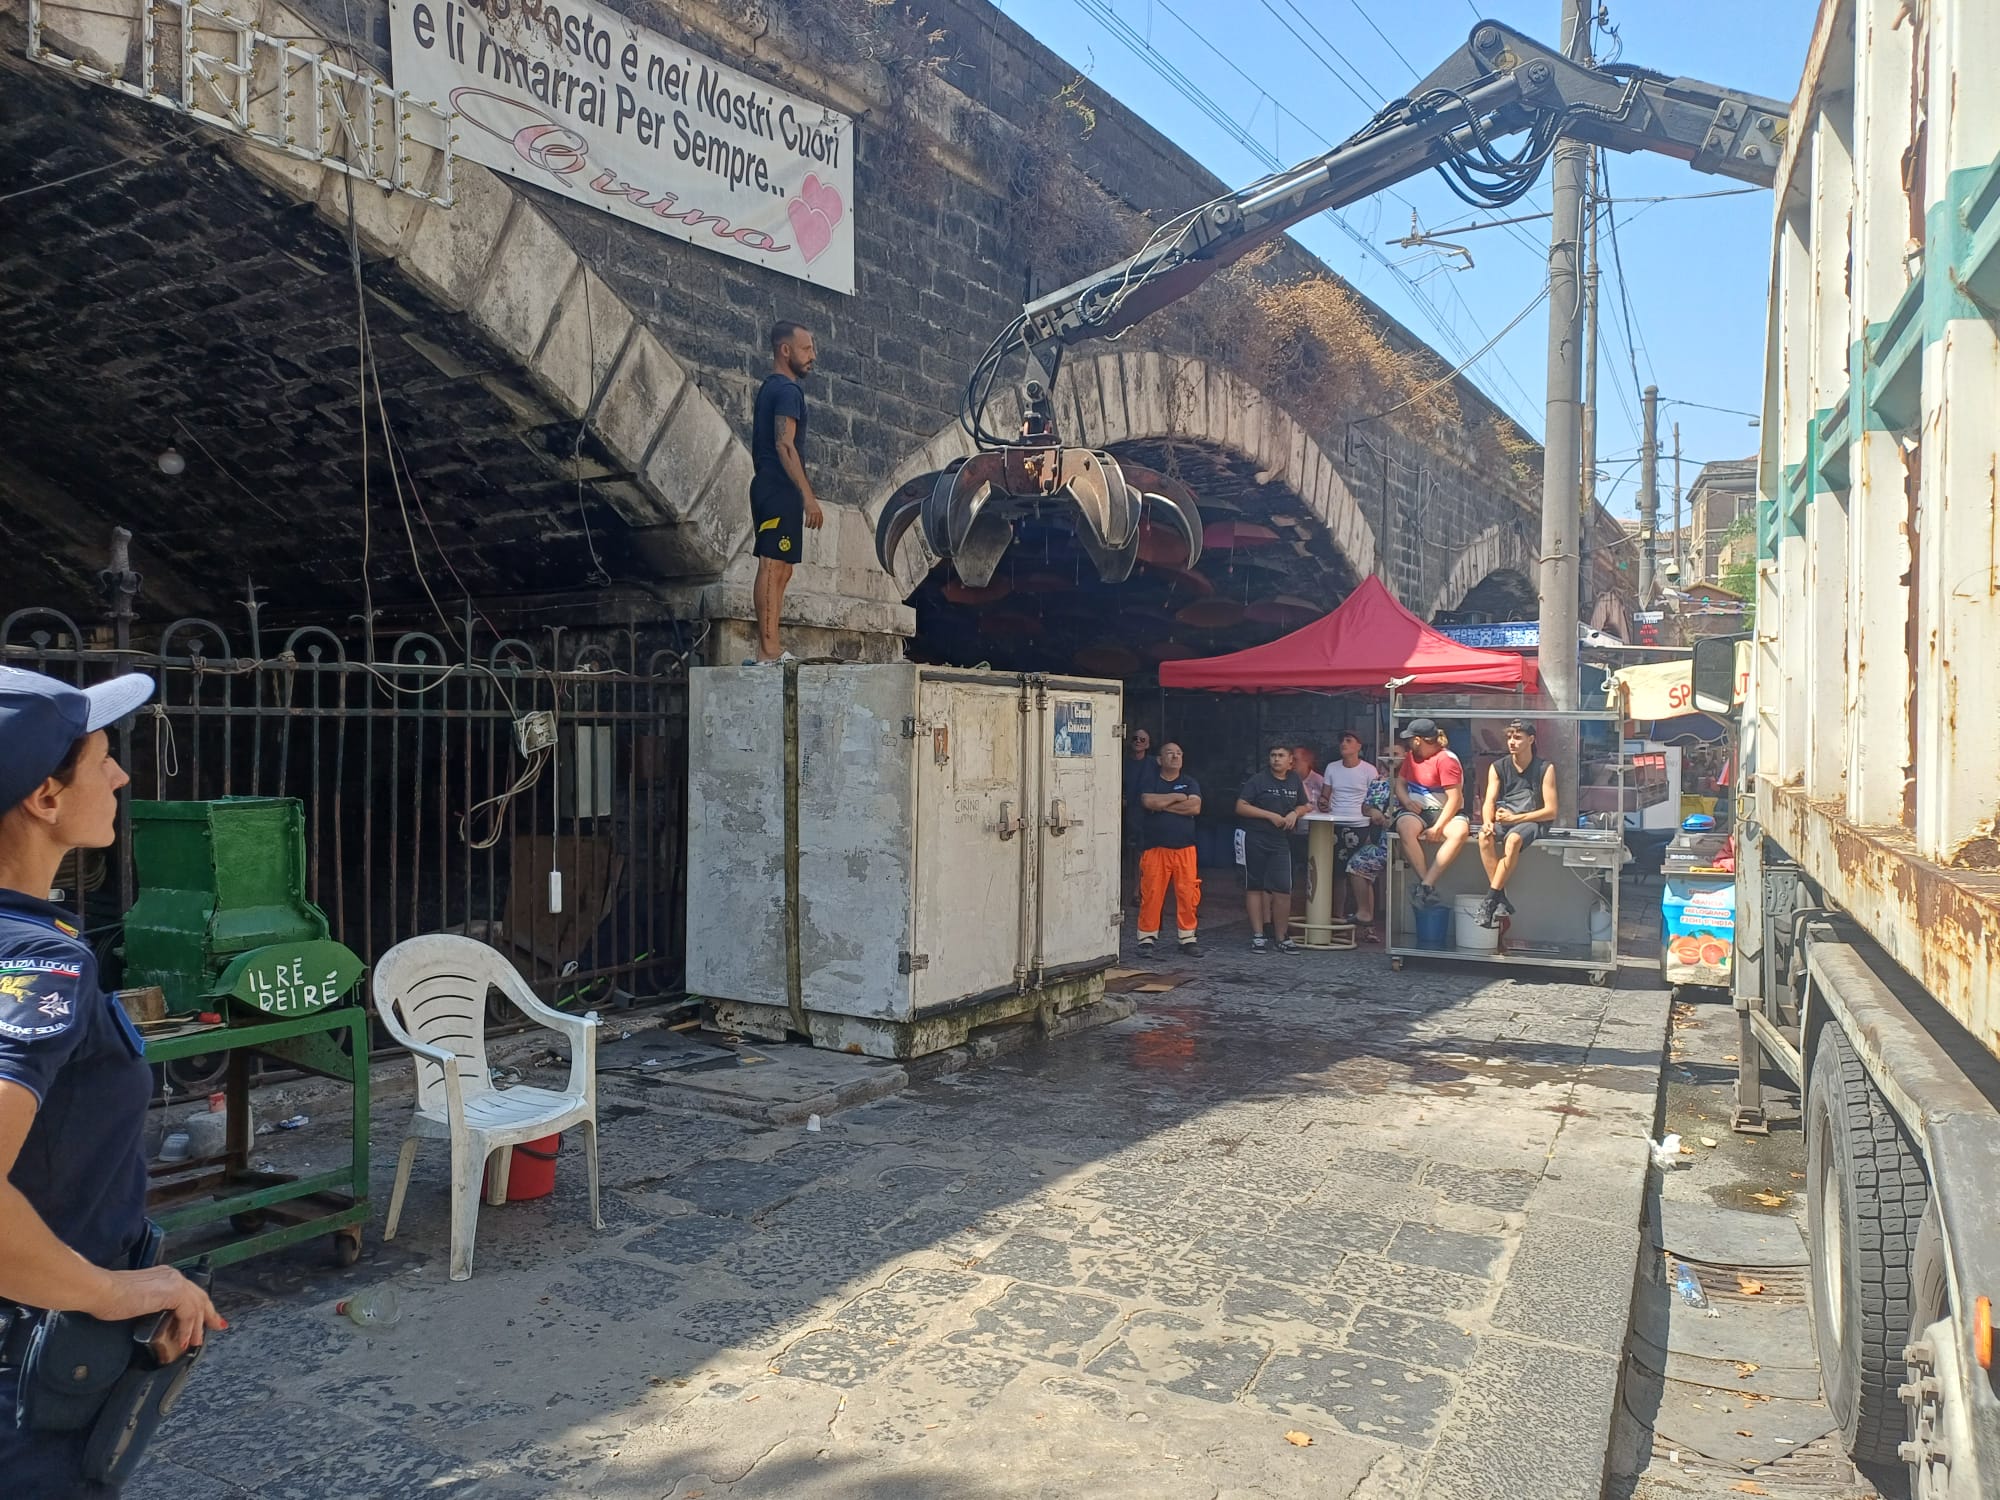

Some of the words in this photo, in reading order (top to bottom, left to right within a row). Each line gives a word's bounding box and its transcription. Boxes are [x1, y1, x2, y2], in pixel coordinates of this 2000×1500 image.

[413, 3, 434, 49] e
[446, 2, 464, 64] li
[616, 83, 665, 149] Per
[648, 57, 691, 106] nei
[697, 64, 773, 141] Nostri
[779, 105, 838, 168] Cuori
[449, 87, 790, 252] Cirino
[40, 960, 80, 973] LOCALE
[259, 987, 297, 1012] DEI
[303, 969, 339, 1008] RÉ
[276, 957, 304, 987] RÉ
